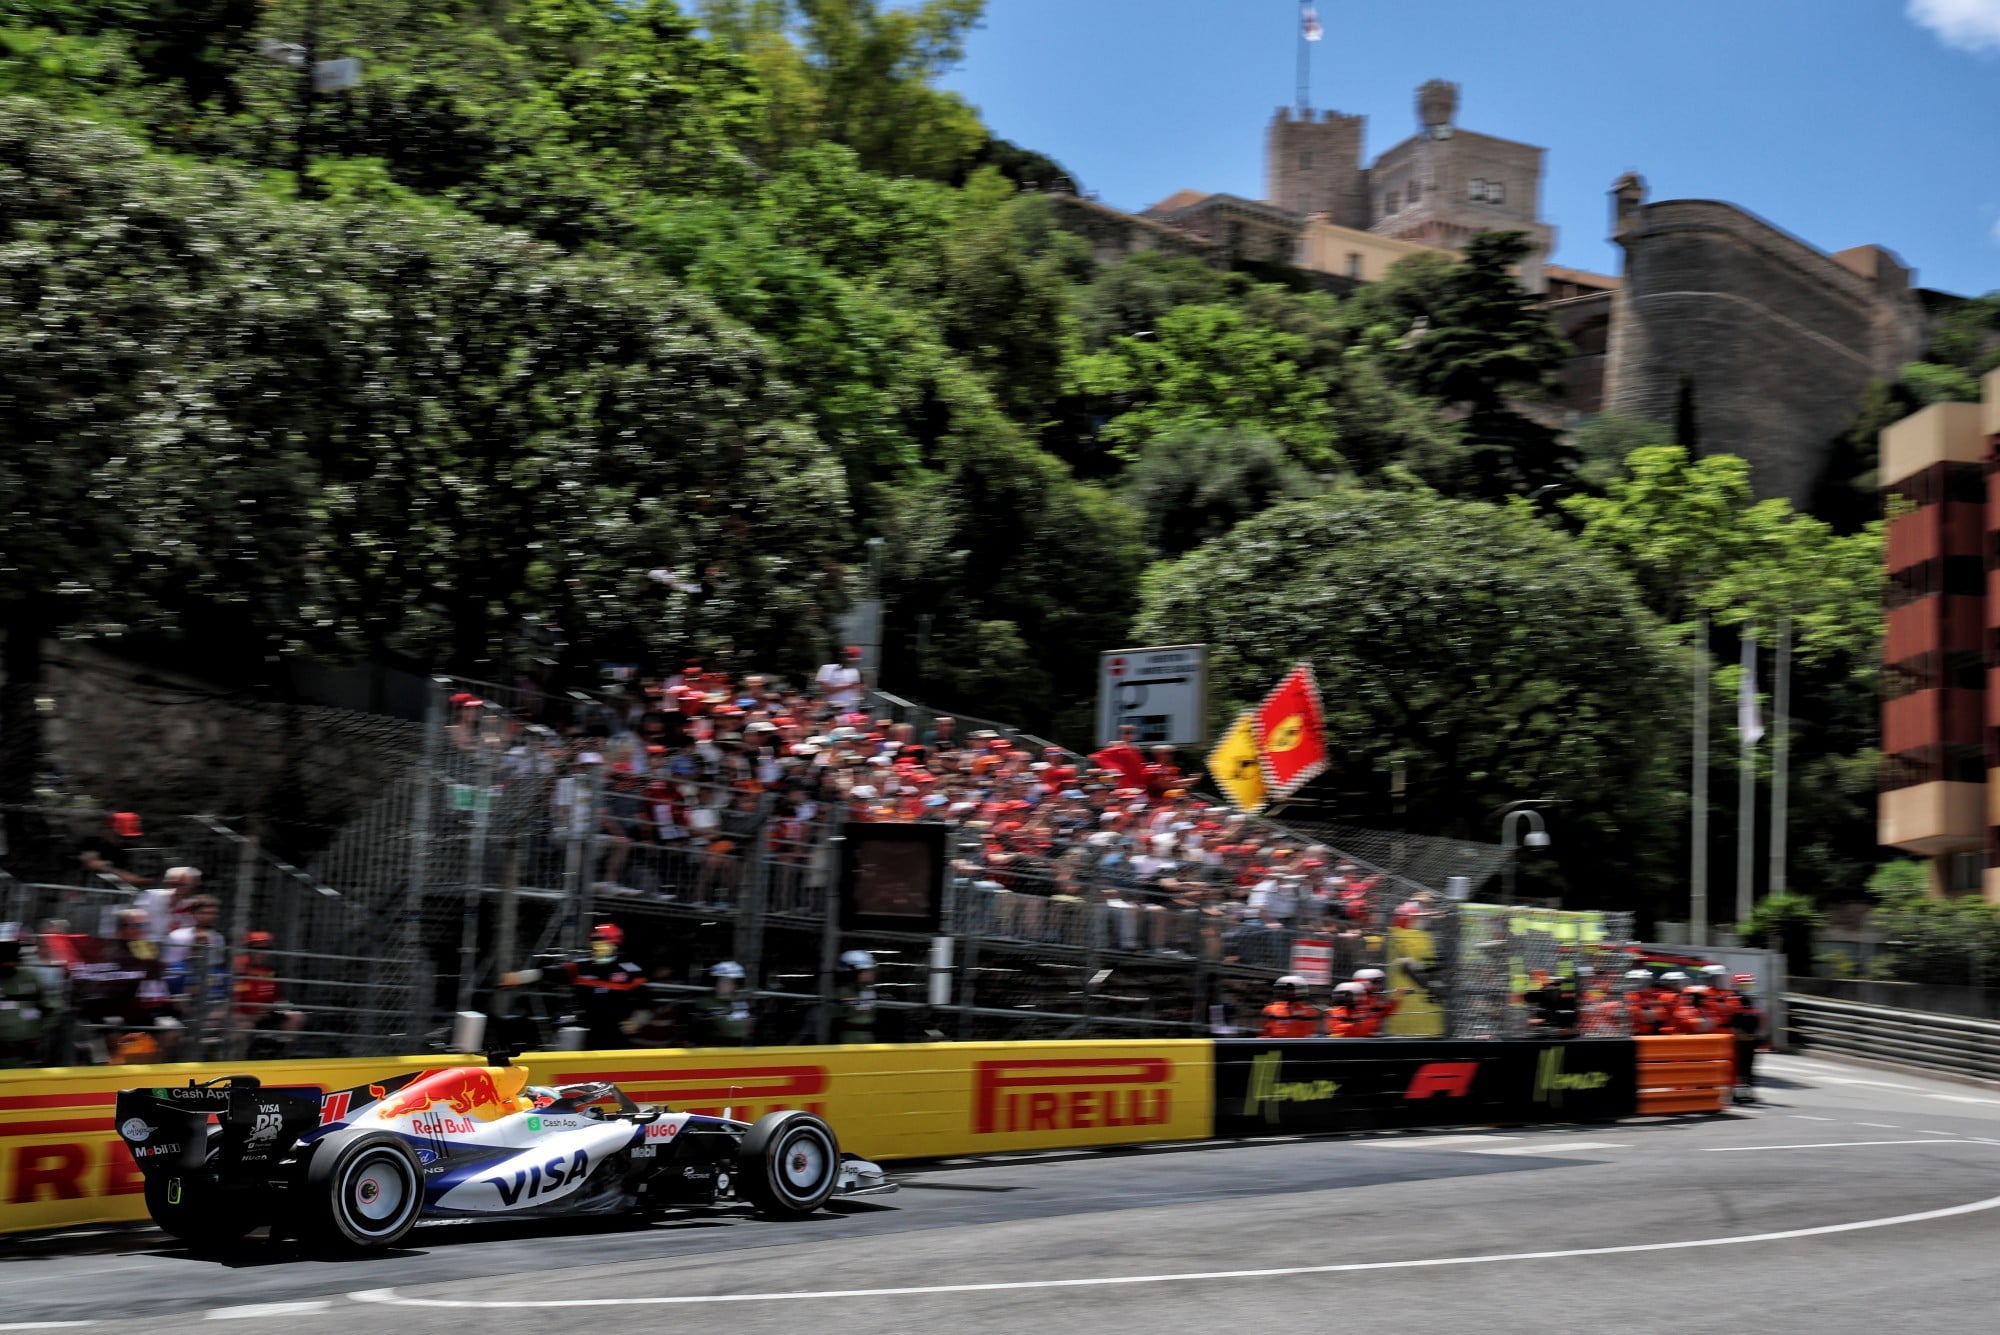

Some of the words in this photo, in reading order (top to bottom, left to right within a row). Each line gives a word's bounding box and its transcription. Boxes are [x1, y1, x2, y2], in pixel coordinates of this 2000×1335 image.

[172, 1088, 204, 1099] Cash
[970, 1058, 1174, 1134] PIRELLI
[259, 1103, 280, 1113] VISA
[412, 1118, 443, 1134] Red
[444, 1117, 475, 1133] Bull
[543, 1119, 561, 1127] Cash
[562, 1119, 577, 1127] App
[645, 1123, 677, 1137] HUGO
[135, 1144, 169, 1158] Mobil
[480, 1149, 589, 1207] VISA
